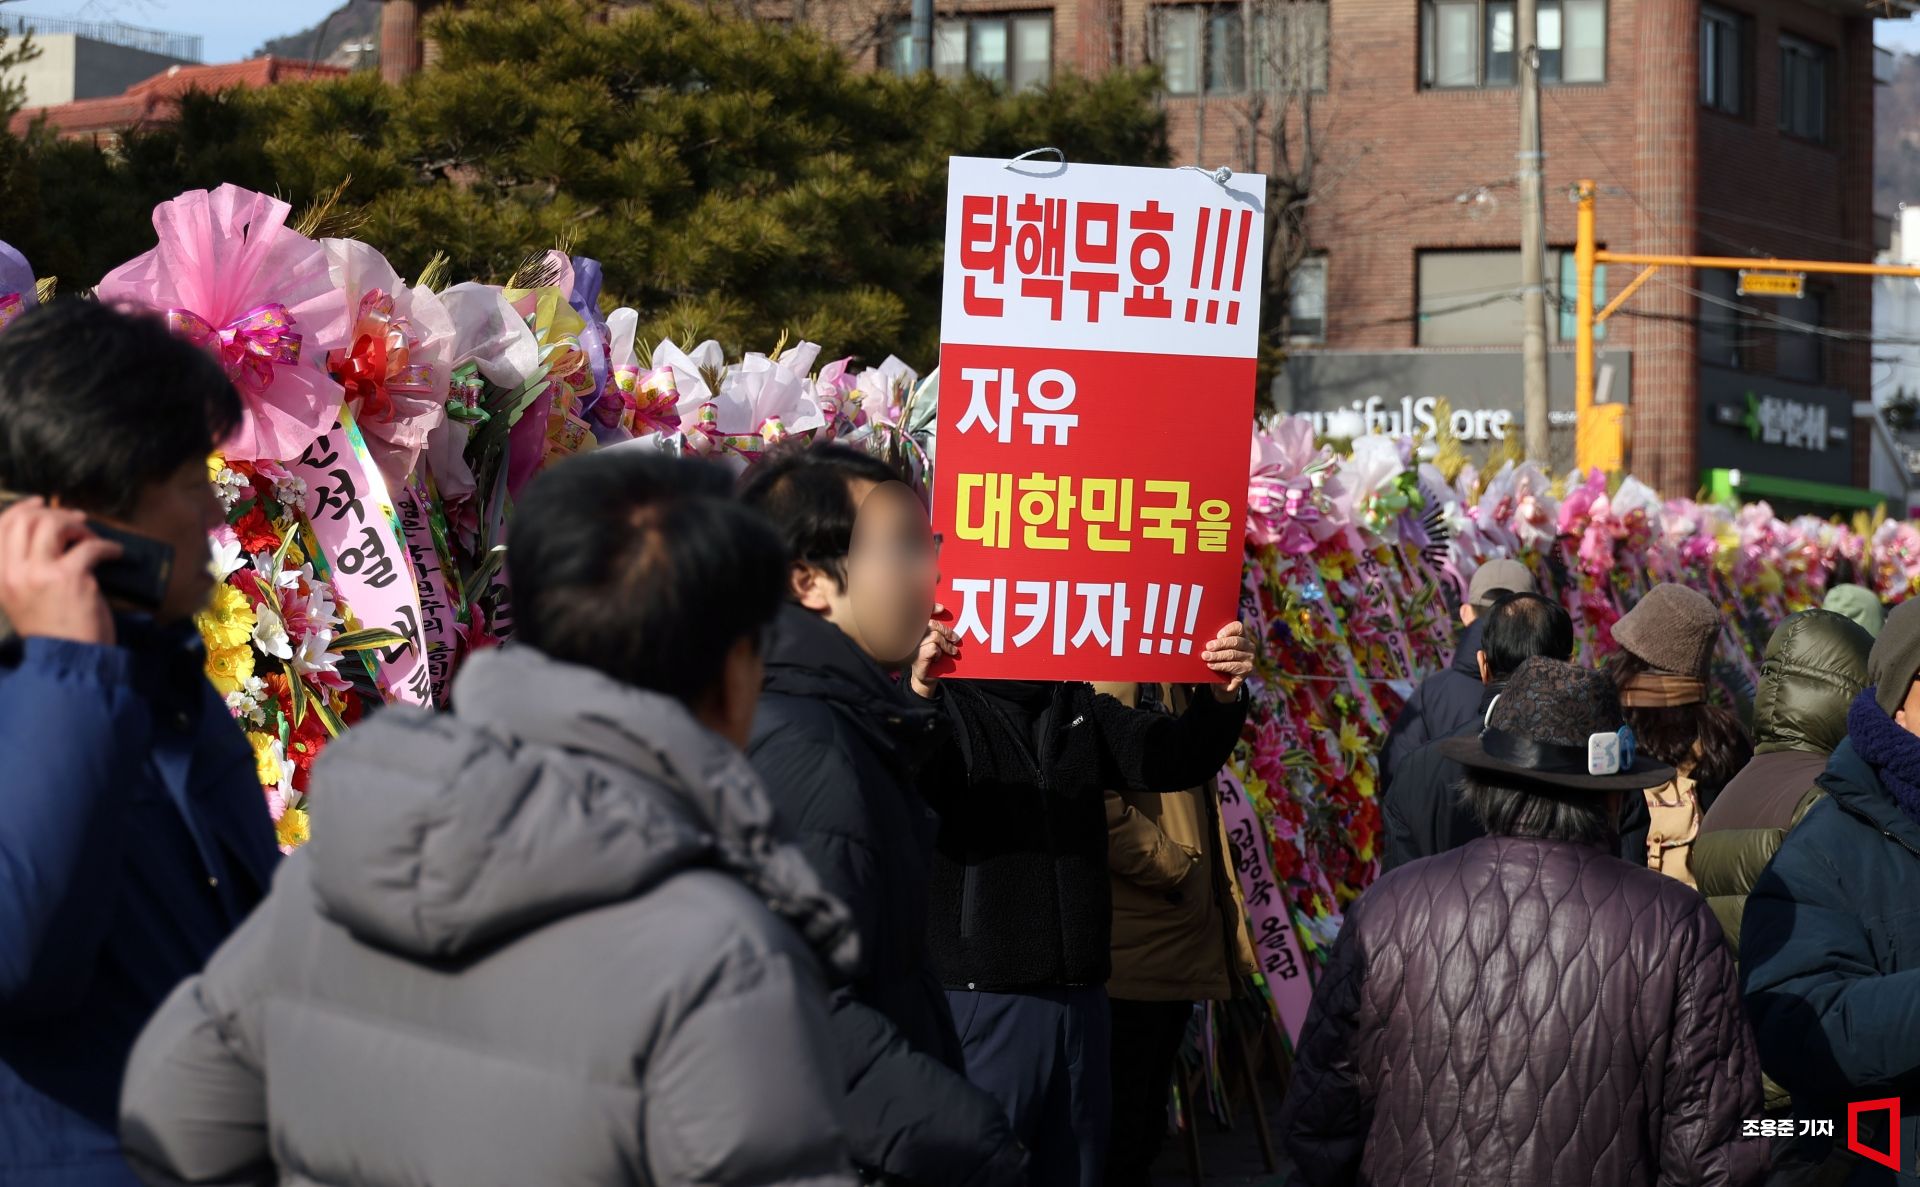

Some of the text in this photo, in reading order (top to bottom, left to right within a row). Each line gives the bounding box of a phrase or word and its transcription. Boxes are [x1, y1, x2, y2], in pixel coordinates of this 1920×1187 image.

[959, 194, 1252, 325] 탄핵무효!!!
[955, 367, 1080, 446] 자유
[954, 472, 1232, 554] 대한민국을
[951, 578, 1203, 657] 지키자!!!
[1229, 818, 1275, 906] 김영숙
[1256, 916, 1299, 980] 올림
